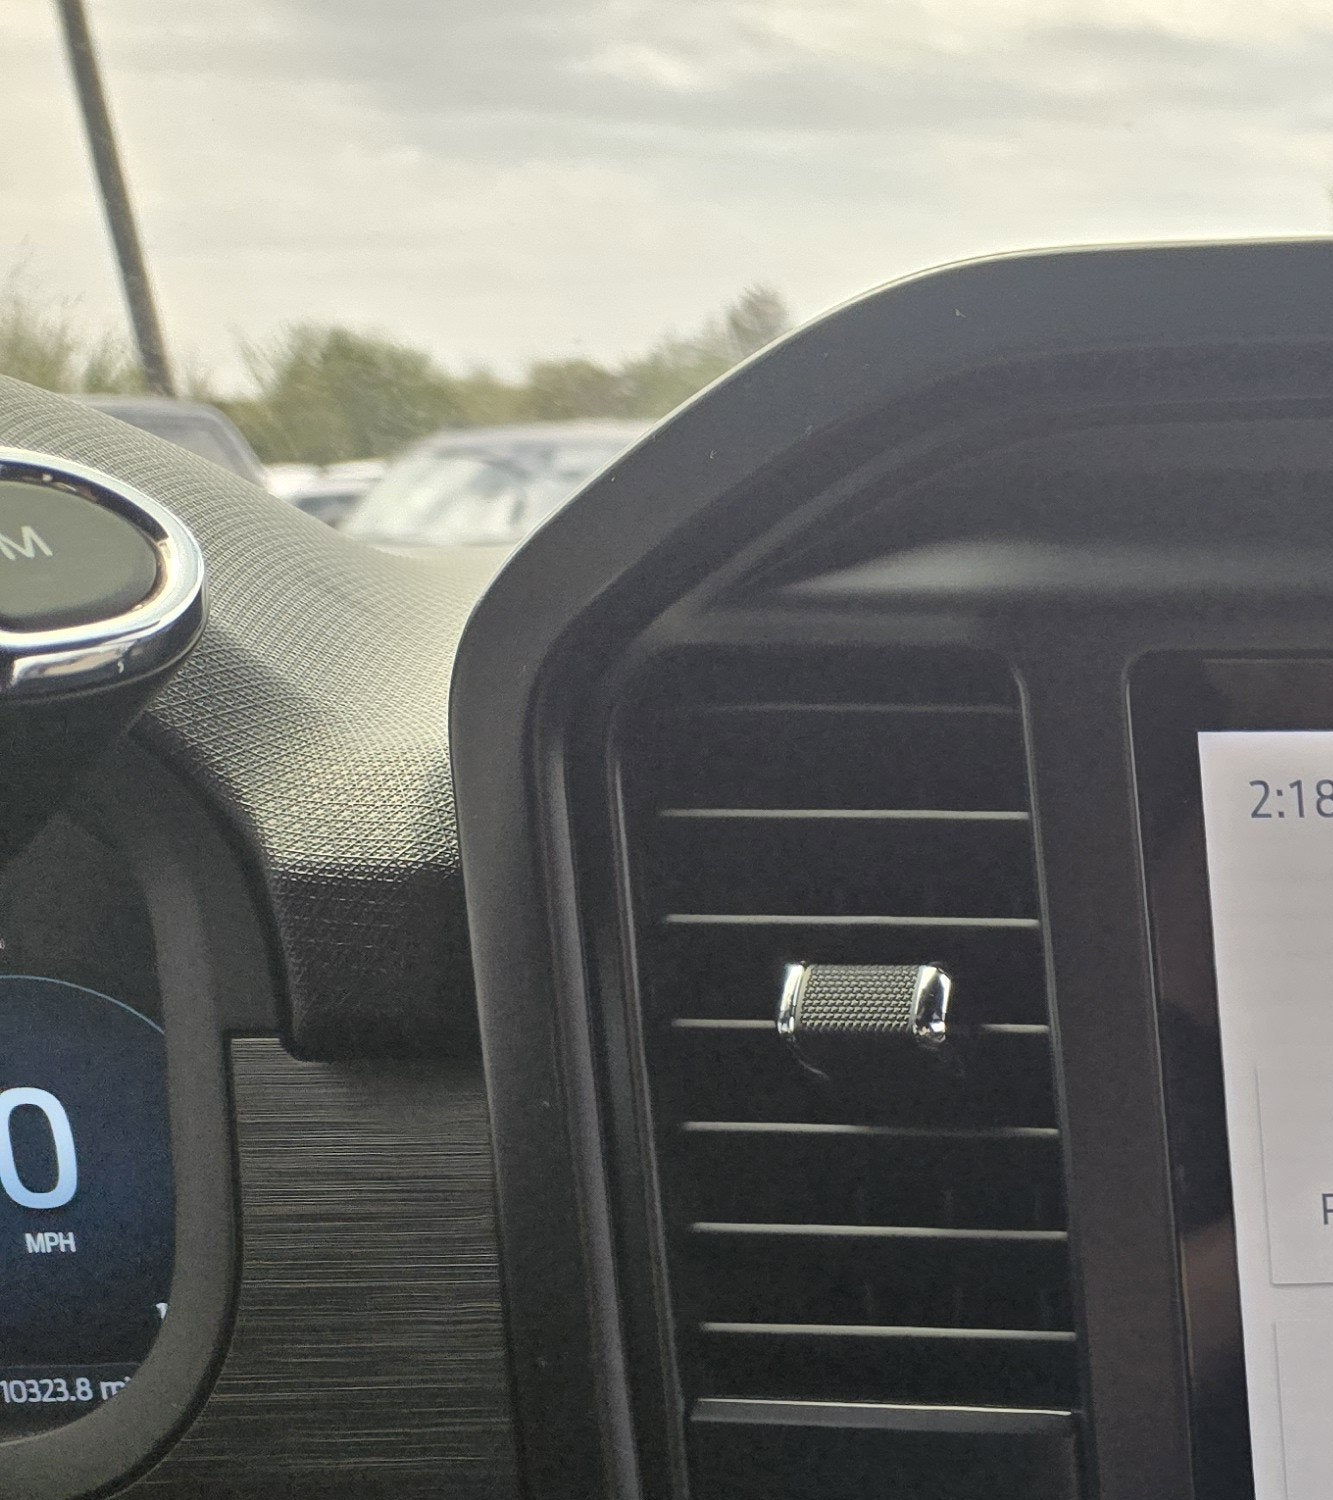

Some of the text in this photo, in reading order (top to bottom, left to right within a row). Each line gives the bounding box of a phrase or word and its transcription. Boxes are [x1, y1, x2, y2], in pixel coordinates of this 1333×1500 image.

[0, 1086, 78, 1209] 0
[24, 1232, 76, 1253] MPH
[0, 1377, 93, 1403] 10323.8
